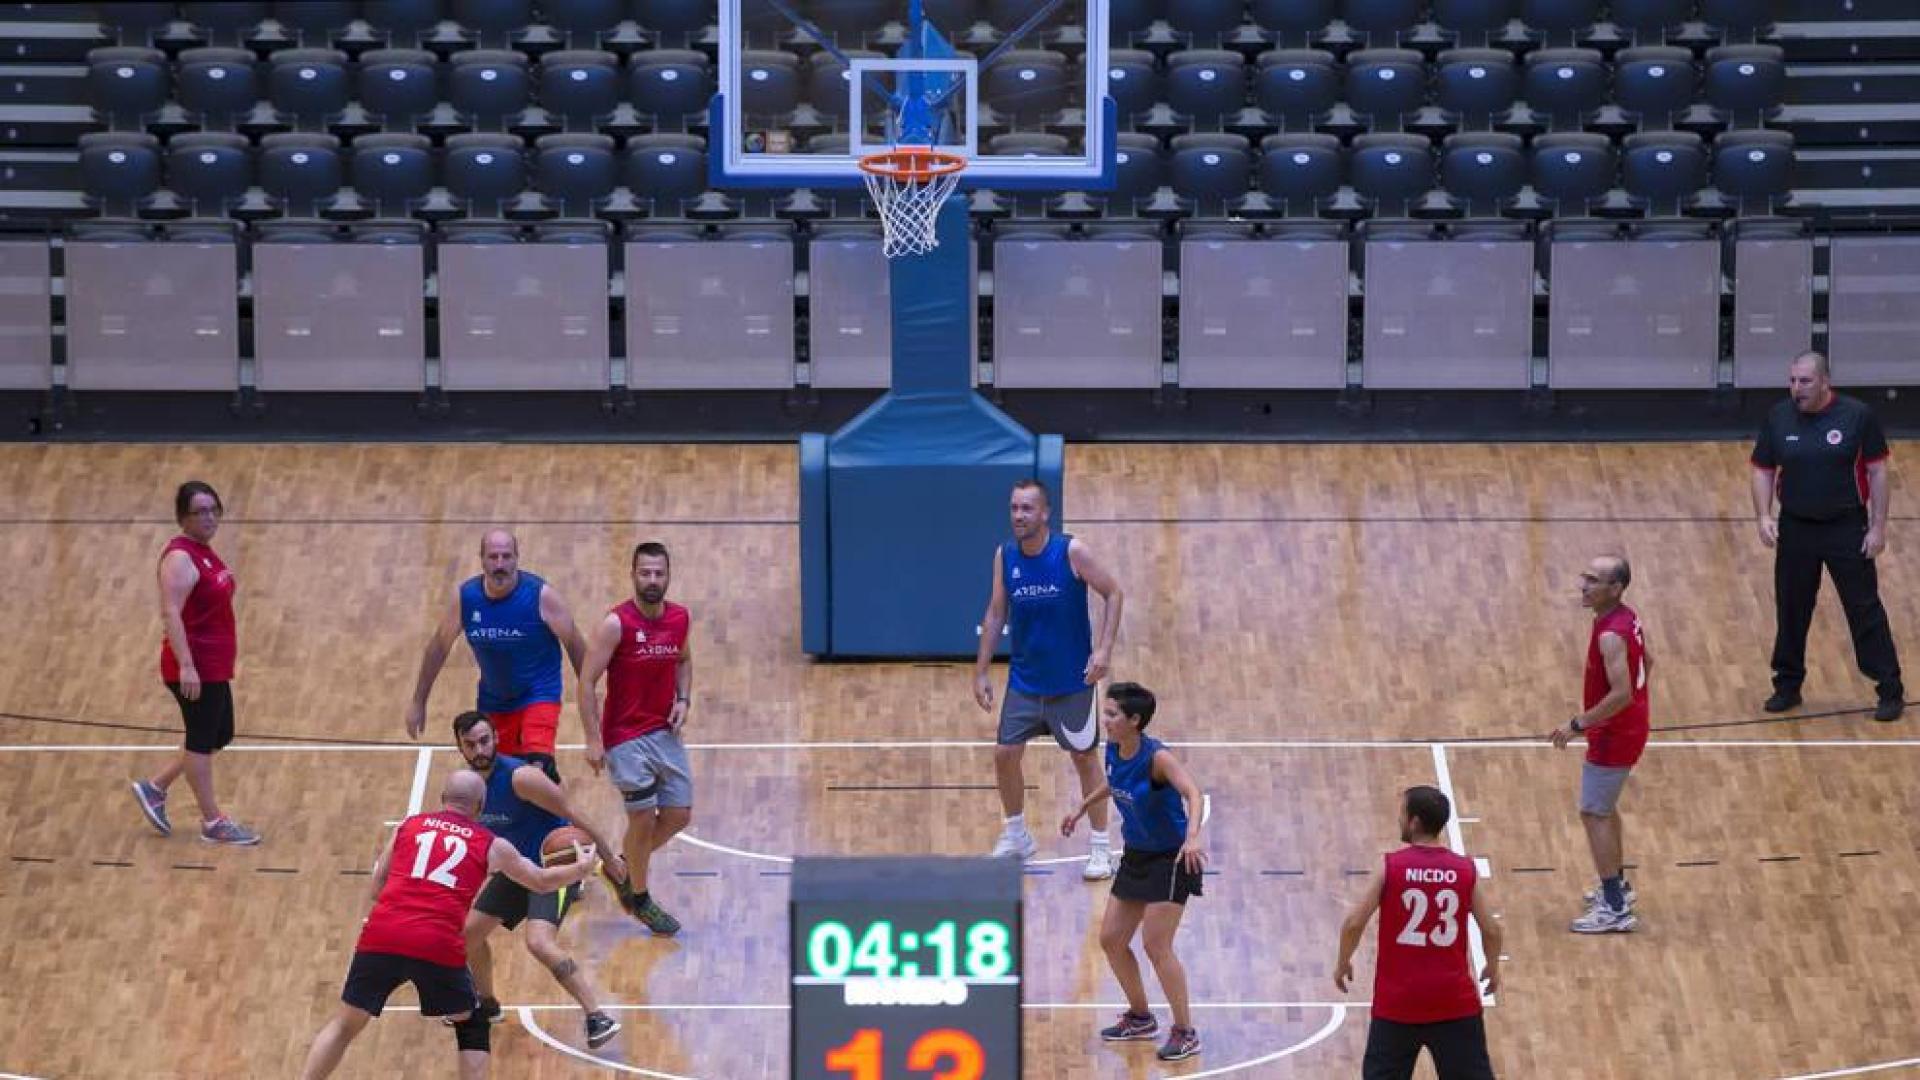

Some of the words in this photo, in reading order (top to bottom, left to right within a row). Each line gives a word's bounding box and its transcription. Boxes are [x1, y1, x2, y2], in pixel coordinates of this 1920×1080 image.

[423, 818, 474, 838] NICDO
[411, 830, 468, 889] 12
[1405, 867, 1458, 884] NICDO
[1396, 889, 1459, 946] 23
[806, 919, 1012, 979] 04:18
